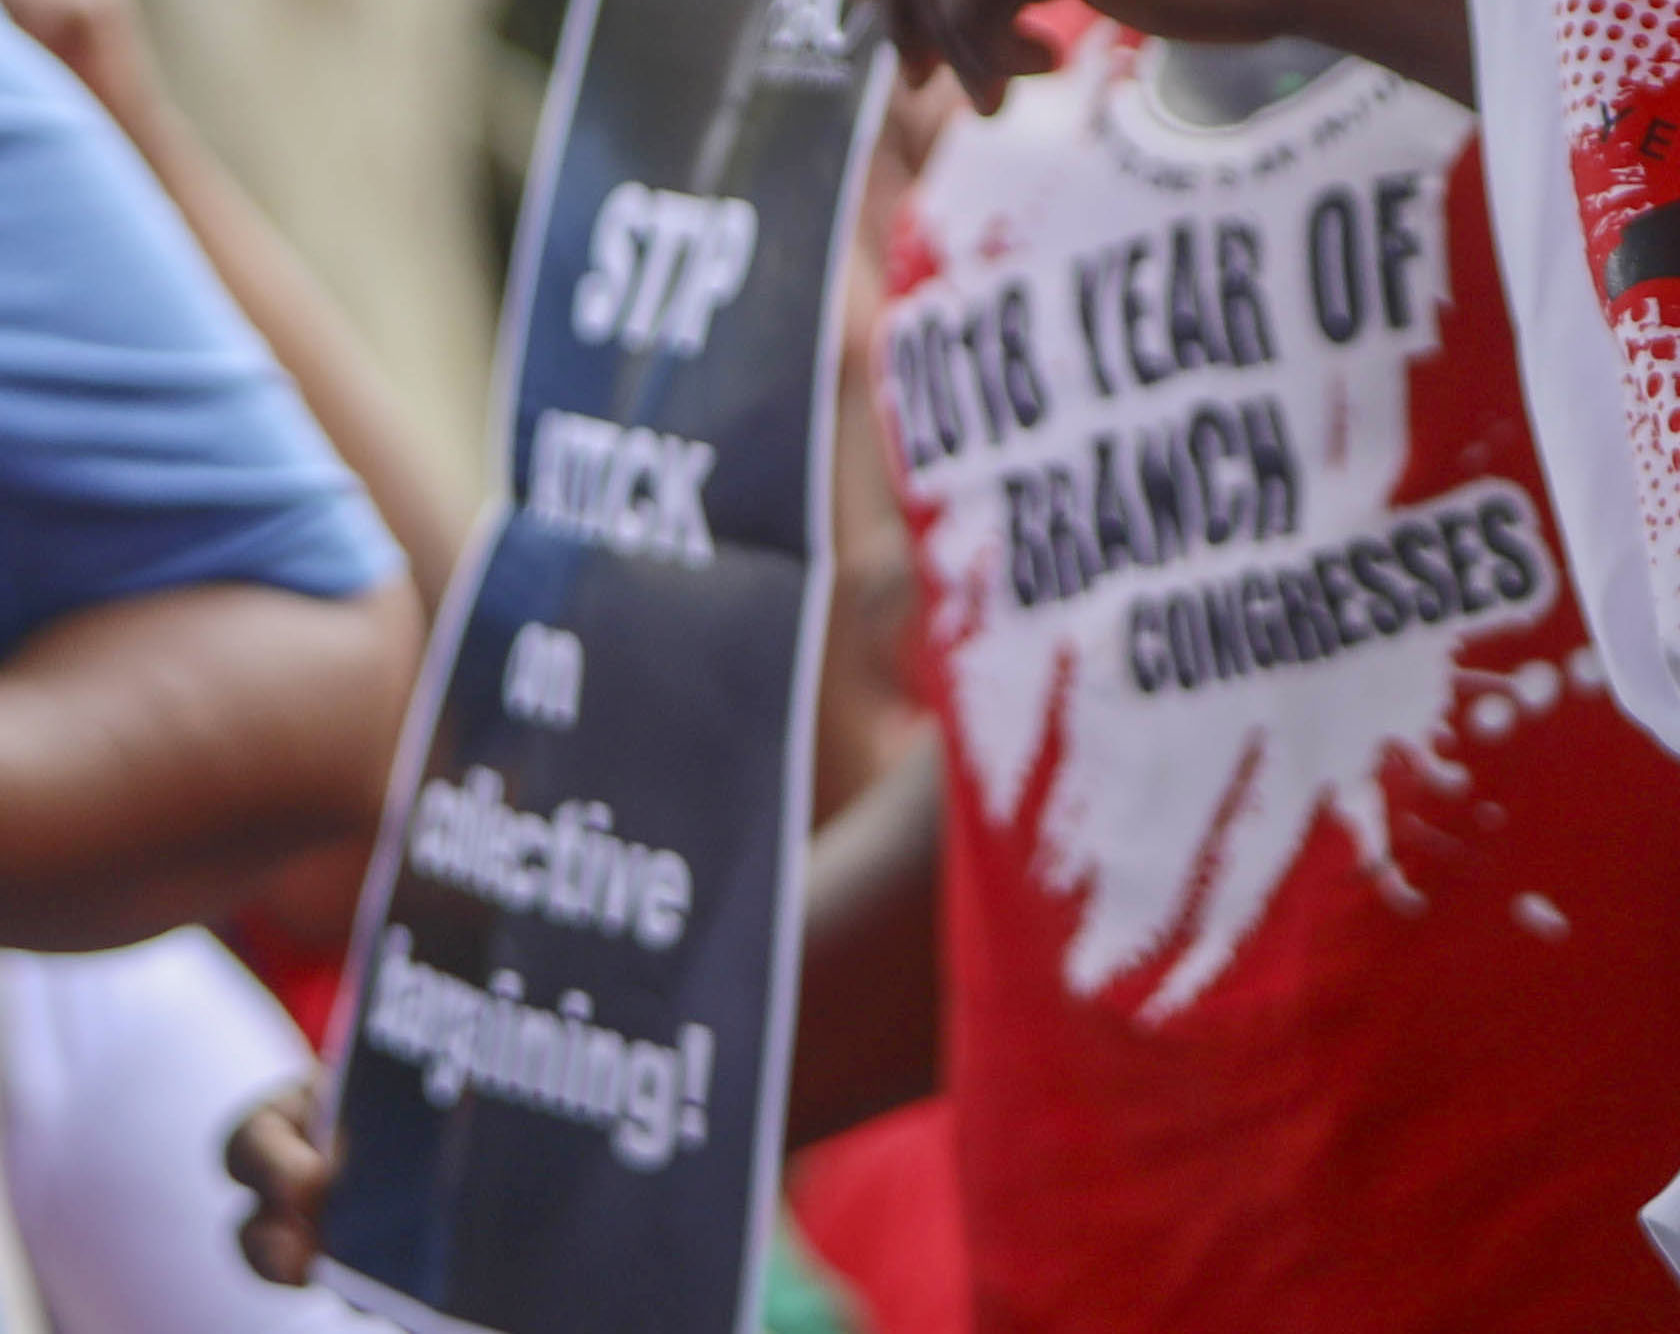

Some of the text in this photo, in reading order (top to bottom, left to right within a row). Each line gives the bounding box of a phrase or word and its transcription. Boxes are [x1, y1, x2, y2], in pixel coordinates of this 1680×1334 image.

[893, 172, 1420, 467] 2018 YEAR OF
[1004, 396, 1300, 607] BRANCH
[1128, 496, 1540, 695] CONGRESSES
